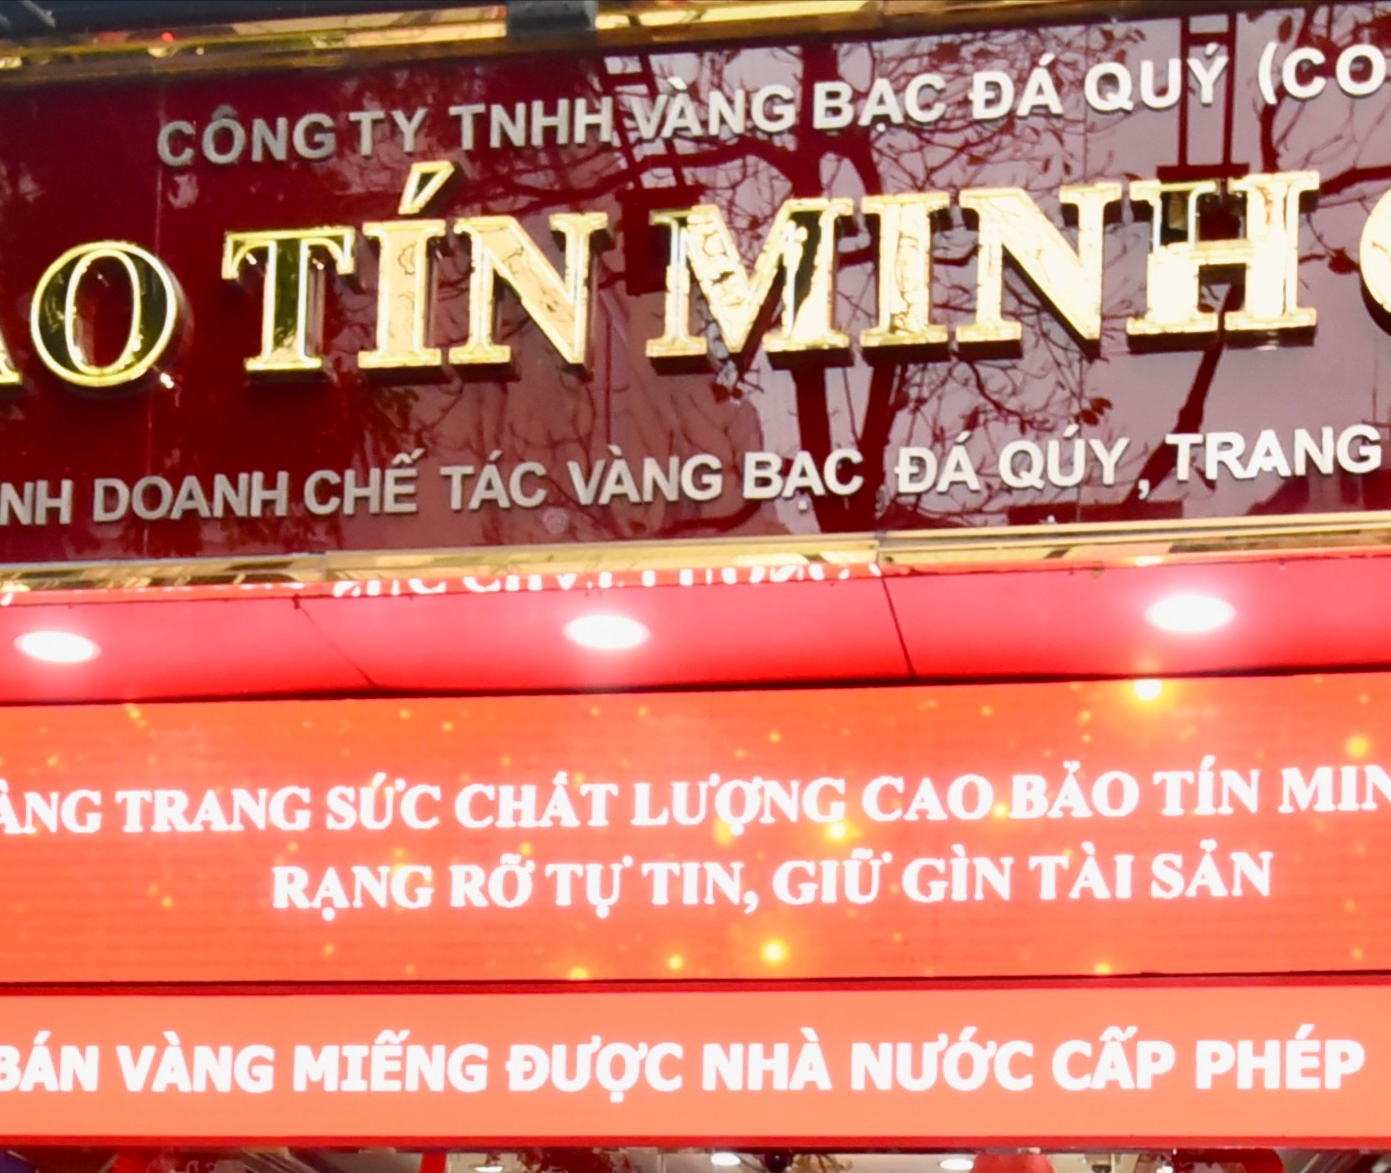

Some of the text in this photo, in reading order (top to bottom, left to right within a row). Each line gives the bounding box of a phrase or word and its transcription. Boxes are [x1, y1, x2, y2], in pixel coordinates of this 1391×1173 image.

[157, 105, 336, 168] CÔNG
[349, 107, 428, 157] TY
[449, 97, 612, 151] TNHH
[631, 77, 796, 140] VÀNG
[813, 74, 947, 132] BẠC
[968, 53, 1065, 120] ĐÁ
[1084, 43, 1229, 112] QUÝ
[222, 160, 608, 375] TÍN
[645, 170, 1319, 361] MINH
[93, 470, 289, 522] DOANH
[304, 449, 425, 517] CHẾ
[439, 449, 547, 511] TÁC
[567, 444, 722, 507] VÀNG
[742, 448, 864, 511] BẠC
[895, 431, 980, 494] ĐÁ
[1165, 424, 1383, 483] TRANG
[114, 786, 312, 833] TRANG
[326, 772, 441, 831] SỨC
[454, 770, 619, 829] CHẤT
[631, 773, 847, 836] LƯỢNG
[861, 774, 996, 822] CAO
[1153, 754, 1261, 817] TÍN
[271, 838, 1275, 921] RẠNG RỠ TỰ TIN, GIỮ GÌN TÀI SẢN
[116, 1030, 275, 1093] VÀNG
[293, 1029, 489, 1093] MIẾNG
[506, 1035, 684, 1103] ĐƯỢC
[702, 1027, 833, 1092] NHÀ
[850, 1027, 1034, 1092] NƯỚC
[1051, 1025, 1177, 1091] CẤP
[1195, 1023, 1366, 1091] PHÉP
